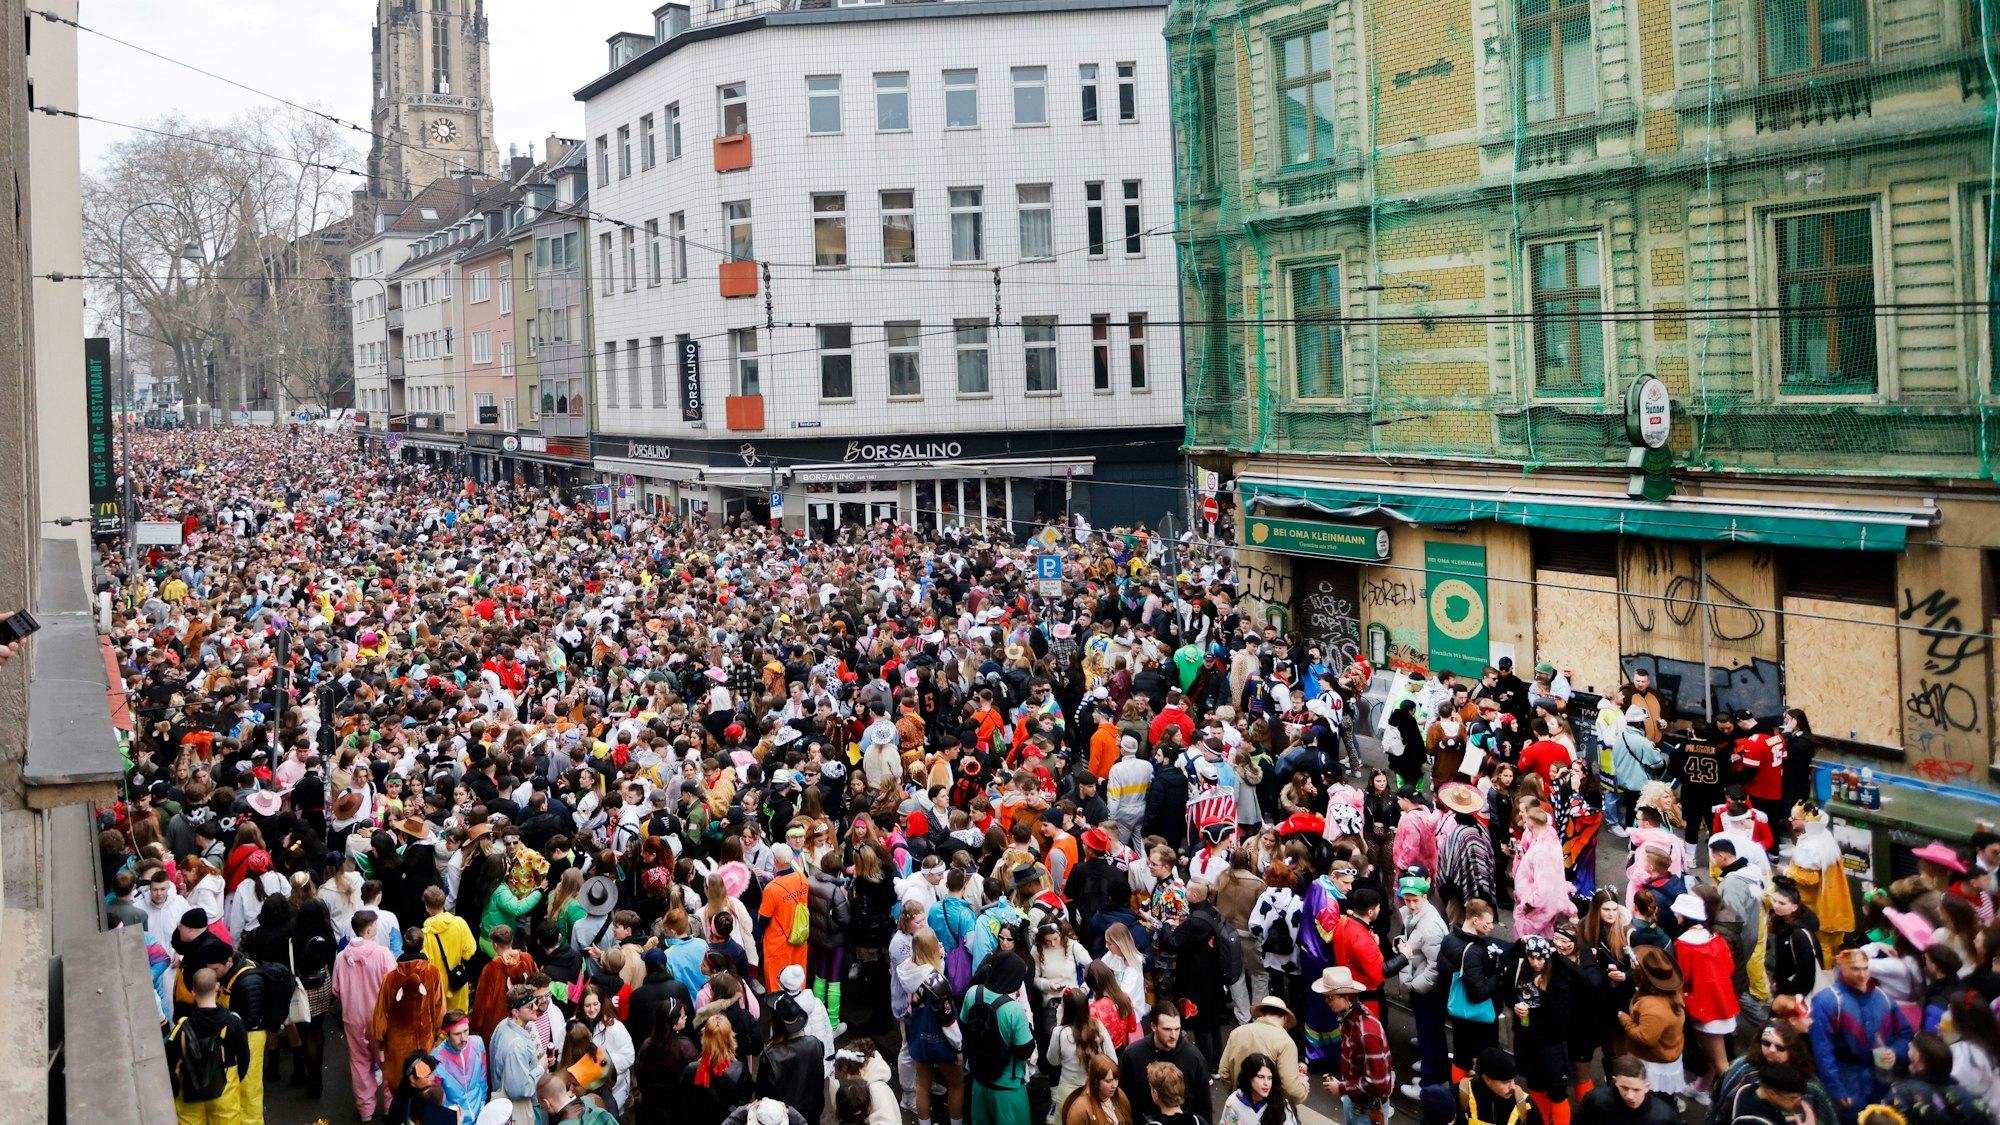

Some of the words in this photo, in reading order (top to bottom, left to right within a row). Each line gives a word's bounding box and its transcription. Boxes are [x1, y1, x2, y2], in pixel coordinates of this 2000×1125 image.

[90, 359, 104, 424] RESTAURANT
[686, 344, 699, 419] BORSALINO
[93, 433, 105, 453] BAR
[628, 440, 671, 460] BORSALINO
[843, 439, 962, 463] BORSALINO
[93, 461, 106, 488] CAFÉ
[803, 472, 855, 481] BORSALINO
[772, 493, 780, 505] P
[1273, 527, 1287, 537] BEI
[1289, 529, 1310, 540] OMA
[1311, 531, 1366, 545] KLEINMANN
[1043, 558, 1057, 577] P
[1451, 559, 1484, 568] KLEINMANN
[924, 692, 935, 713] 5
[1683, 755, 1719, 785] 43
